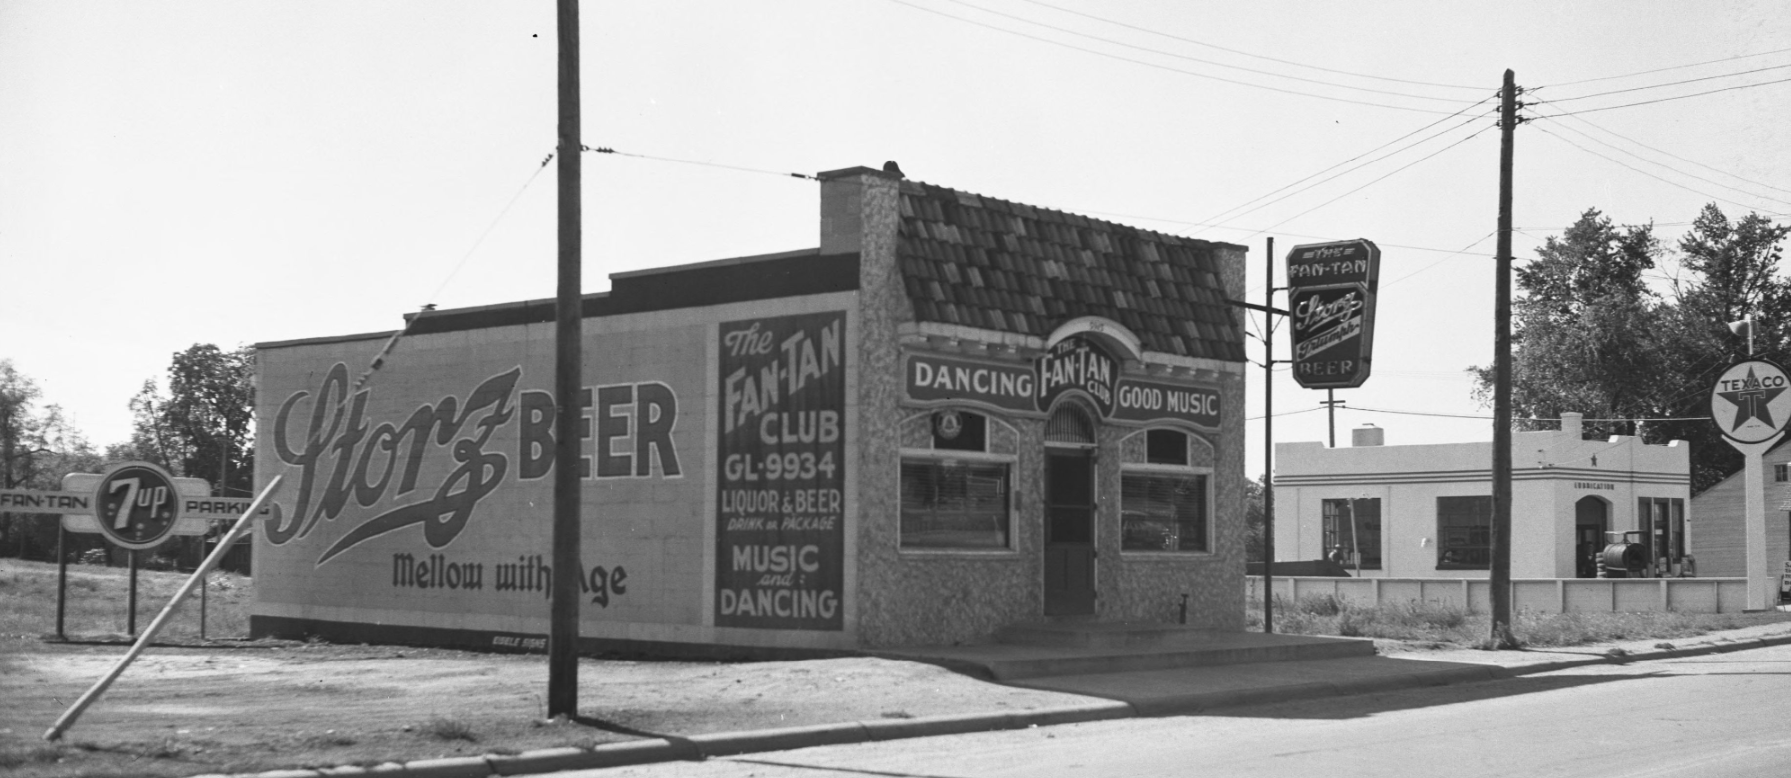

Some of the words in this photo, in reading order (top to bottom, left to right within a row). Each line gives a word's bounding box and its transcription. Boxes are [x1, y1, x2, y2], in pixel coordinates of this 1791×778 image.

[1314, 247, 1343, 259] THE
[1289, 260, 1366, 278] FAN-TAN
[1296, 291, 1364, 333] Storz
[724, 321, 774, 357] The
[1057, 338, 1075, 354] THE
[724, 318, 840, 434] FAN-TAN
[915, 362, 1033, 398] DANCING
[1041, 346, 1110, 398] FAN-TAN
[1300, 360, 1353, 376] BEER
[1087, 380, 1110, 405] CLUB
[1721, 376, 1784, 392] TEXACO
[1120, 386, 1162, 411] GOOD
[1167, 390, 1218, 416] MUSIC
[760, 410, 840, 445] CLUB
[264, 362, 522, 569] Storz
[725, 452, 836, 481] GL-9934
[0, 494, 88, 509] FAN-TAN
[722, 490, 779, 516] LIQUOR
[782, 490, 794, 514] &
[796, 489, 841, 513] BEER
[727, 518, 764, 531] DRINK
[781, 515, 836, 531] PACKAGE
[733, 545, 819, 573] MUSIC
[392, 553, 483, 591] Mellow
[495, 554, 552, 600] with
[720, 588, 838, 618] DANCING
